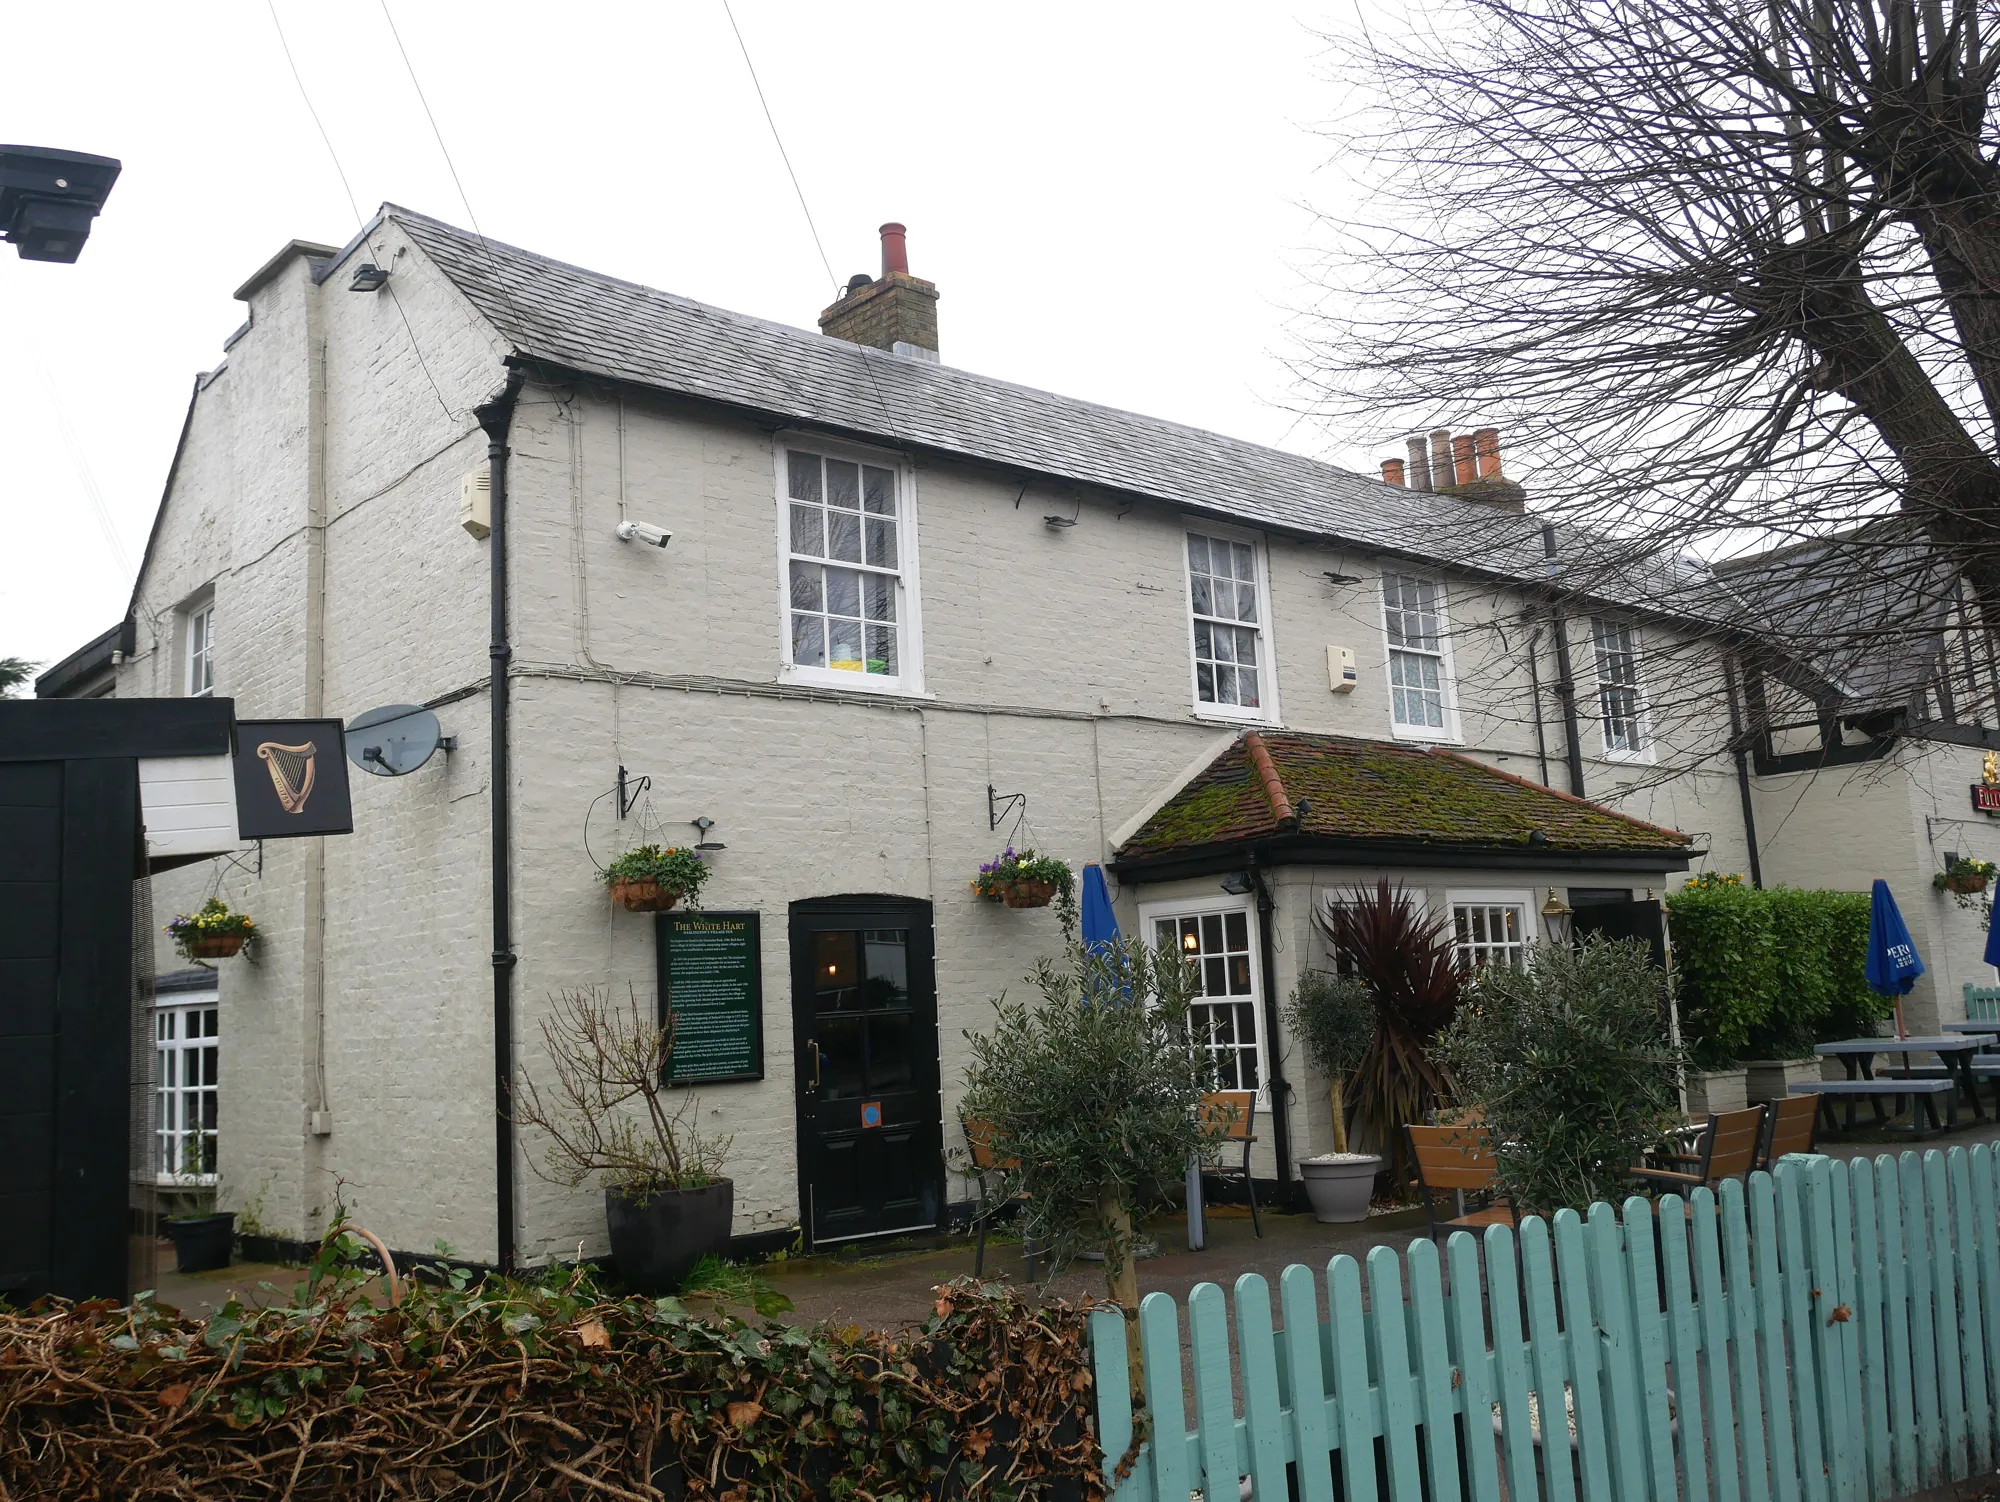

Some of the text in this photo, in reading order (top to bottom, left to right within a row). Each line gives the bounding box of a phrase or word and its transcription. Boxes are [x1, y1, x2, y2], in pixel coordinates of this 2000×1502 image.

[1979, 789, 2000, 806] FULL
[674, 921, 745, 931] THE WHITE HART
